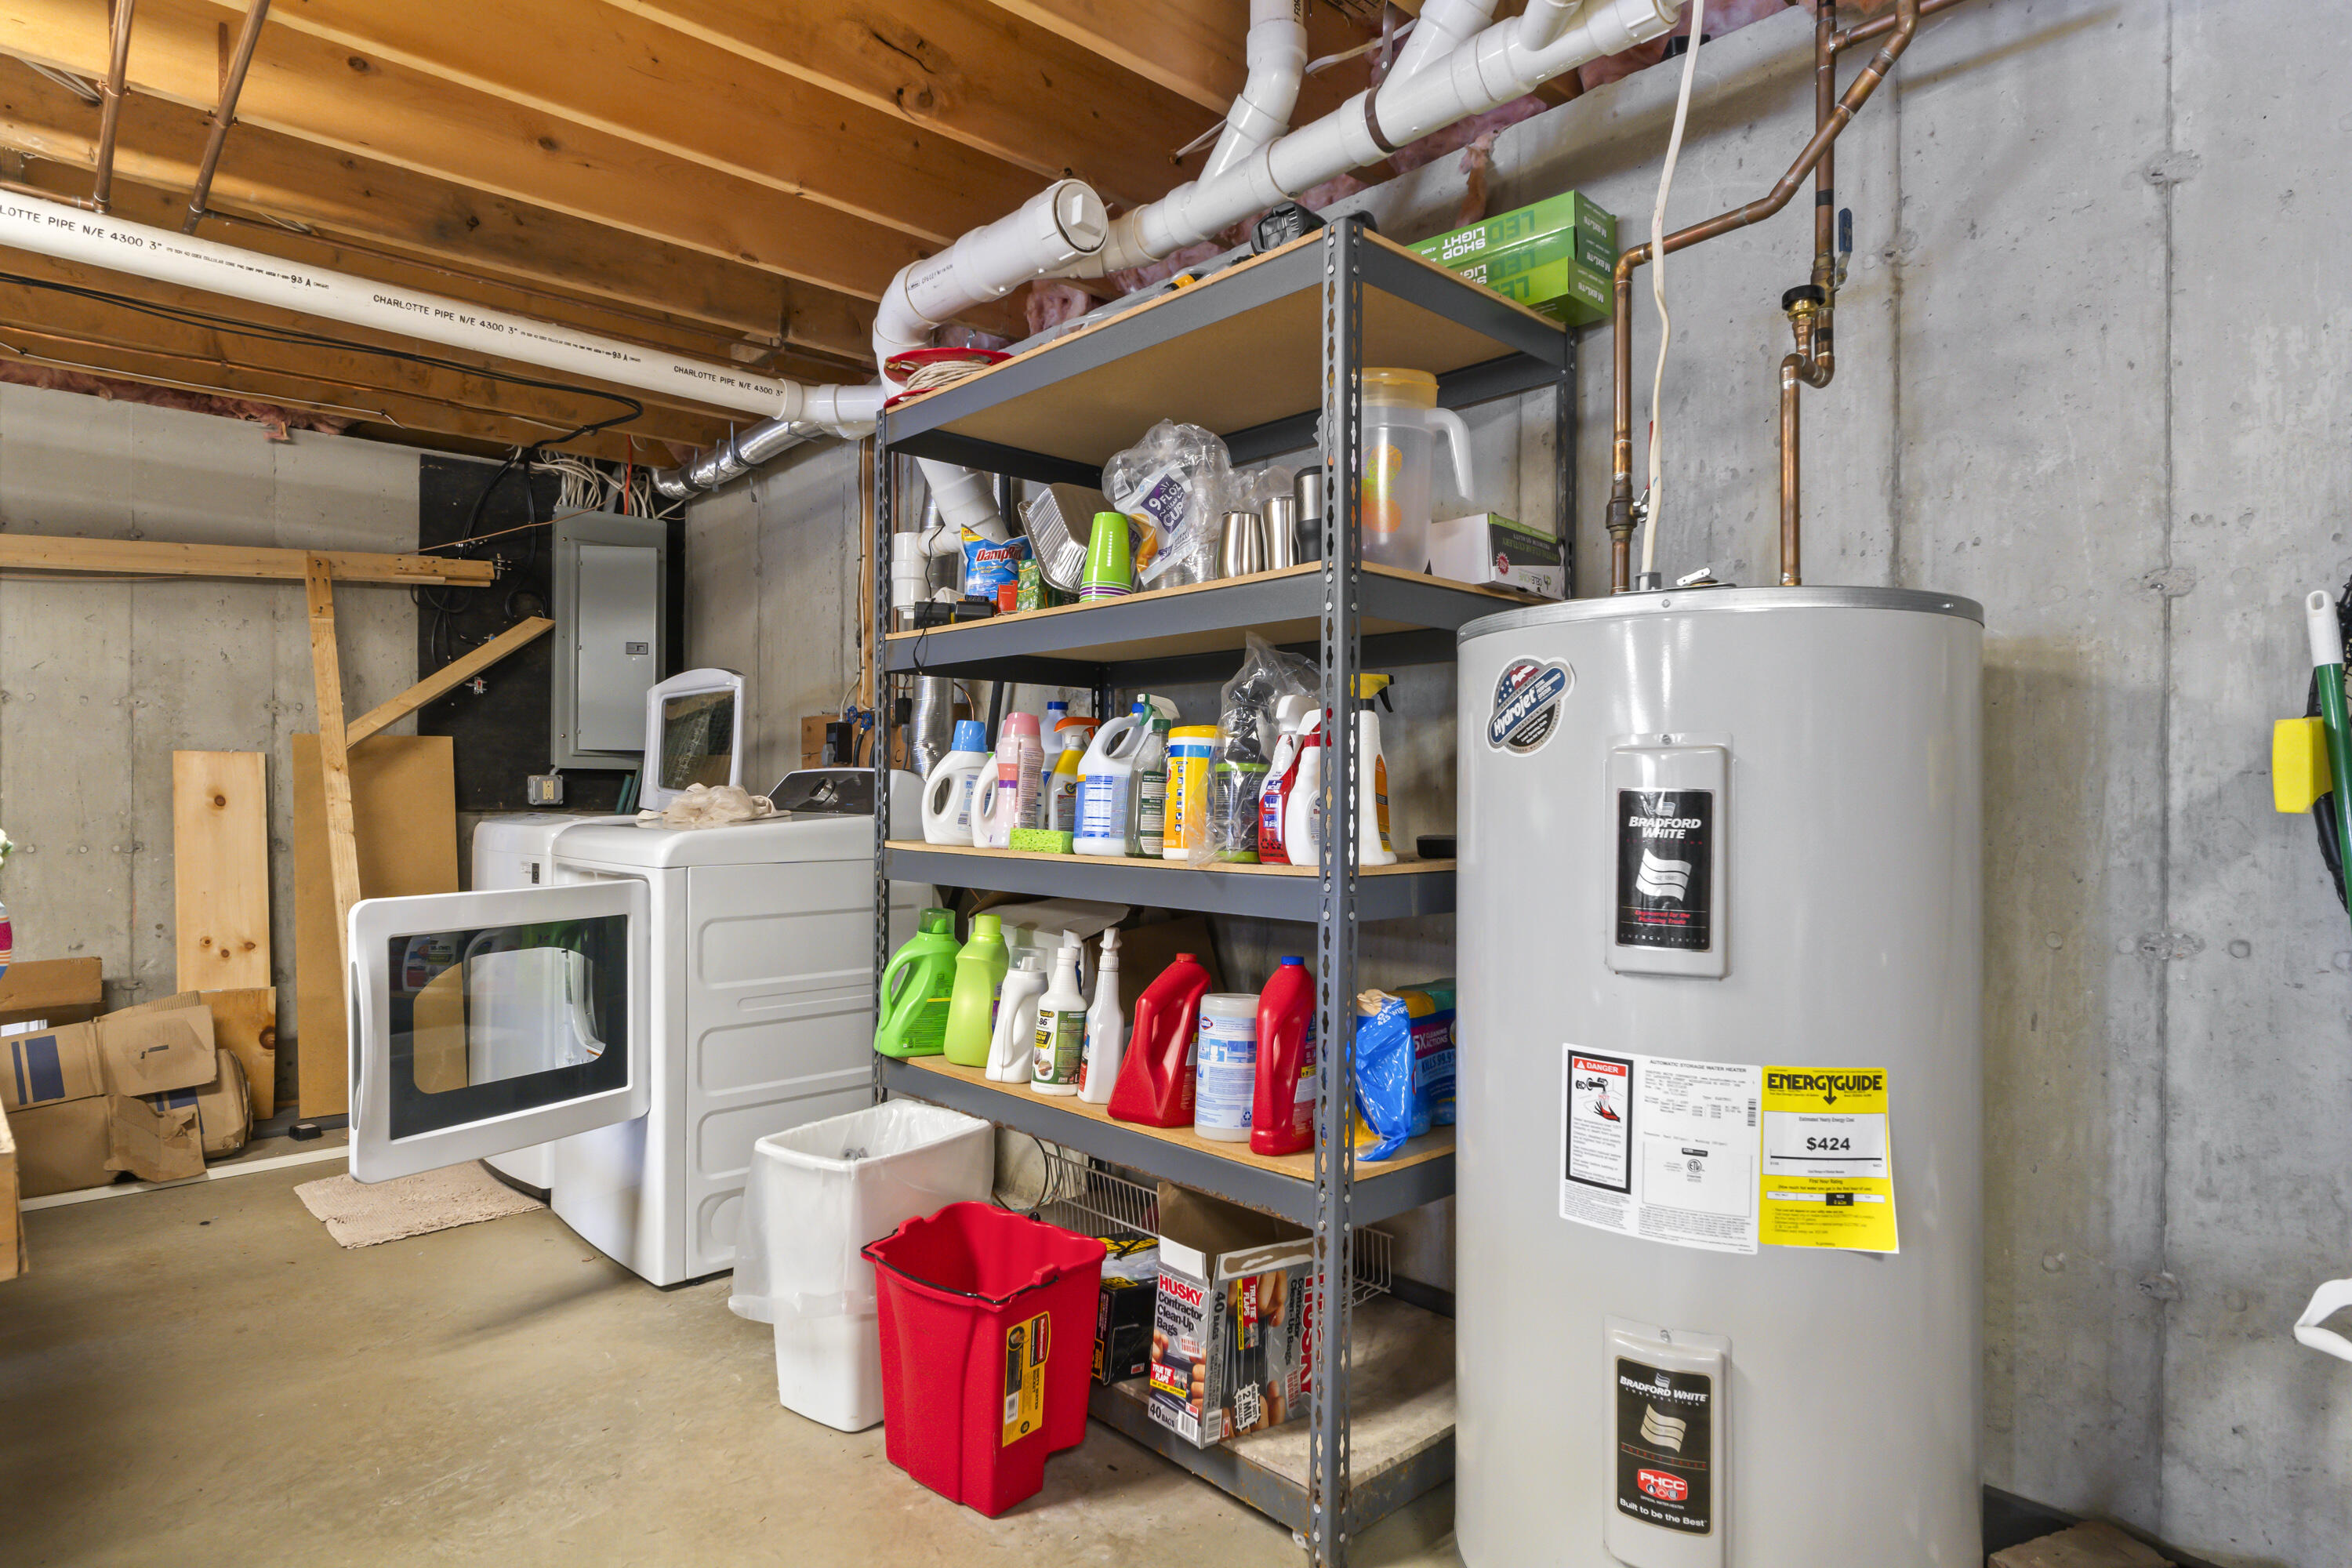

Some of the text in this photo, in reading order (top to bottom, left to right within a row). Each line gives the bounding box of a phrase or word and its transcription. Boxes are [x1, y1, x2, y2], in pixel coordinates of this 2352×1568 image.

[48, 216, 75, 231] PIPE
[82, 225, 105, 238] N/E
[110, 232, 143, 247] 4300
[1487, 209, 1536, 244] LED
[1442, 227, 1486, 249] LIGHT
[1443, 238, 1486, 260] SHOP
[1460, 264, 1486, 279] LIG
[373, 294, 430, 315] CHARLOTTE
[434, 309, 455, 321] PIPE
[459, 315, 476, 326] N/E
[479, 320, 504, 332] 4300
[673, 365, 717, 382] CHARLOTTE
[720, 376, 735, 387] PIPE
[739, 381, 751, 390] N/E
[753, 385, 773, 395] 4300
[1149, 498, 1161, 510] 9
[1494, 687, 1537, 737] Hydrojet
[1628, 816, 1701, 829] BRADFORD
[1642, 827, 1686, 839] WHITE
[1426, 1036, 1448, 1048] ACTIONS
[1586, 1062, 1619, 1073] DANGER
[1806, 1137, 1850, 1152] $424
[1159, 1273, 1203, 1308] HUSKY
[1214, 1291, 1226, 1312] 40
[1158, 1291, 1203, 1322] Contractor
[1294, 1277, 1305, 1338] Contractor
[1156, 1316, 1178, 1336] Bags
[1157, 1304, 1194, 1332] Clean-Up
[1285, 1279, 1298, 1366] Clean-Up Bags
[1155, 1373, 1170, 1384] FLAPS
[1620, 1375, 1706, 1402] BRADFORD WHITE
[1243, 1391, 1250, 1399] 2
[1149, 1403, 1174, 1428] 40 BAGS
[1640, 1472, 1685, 1491] PHCC
[1620, 1497, 1704, 1527] Built to be the Best
